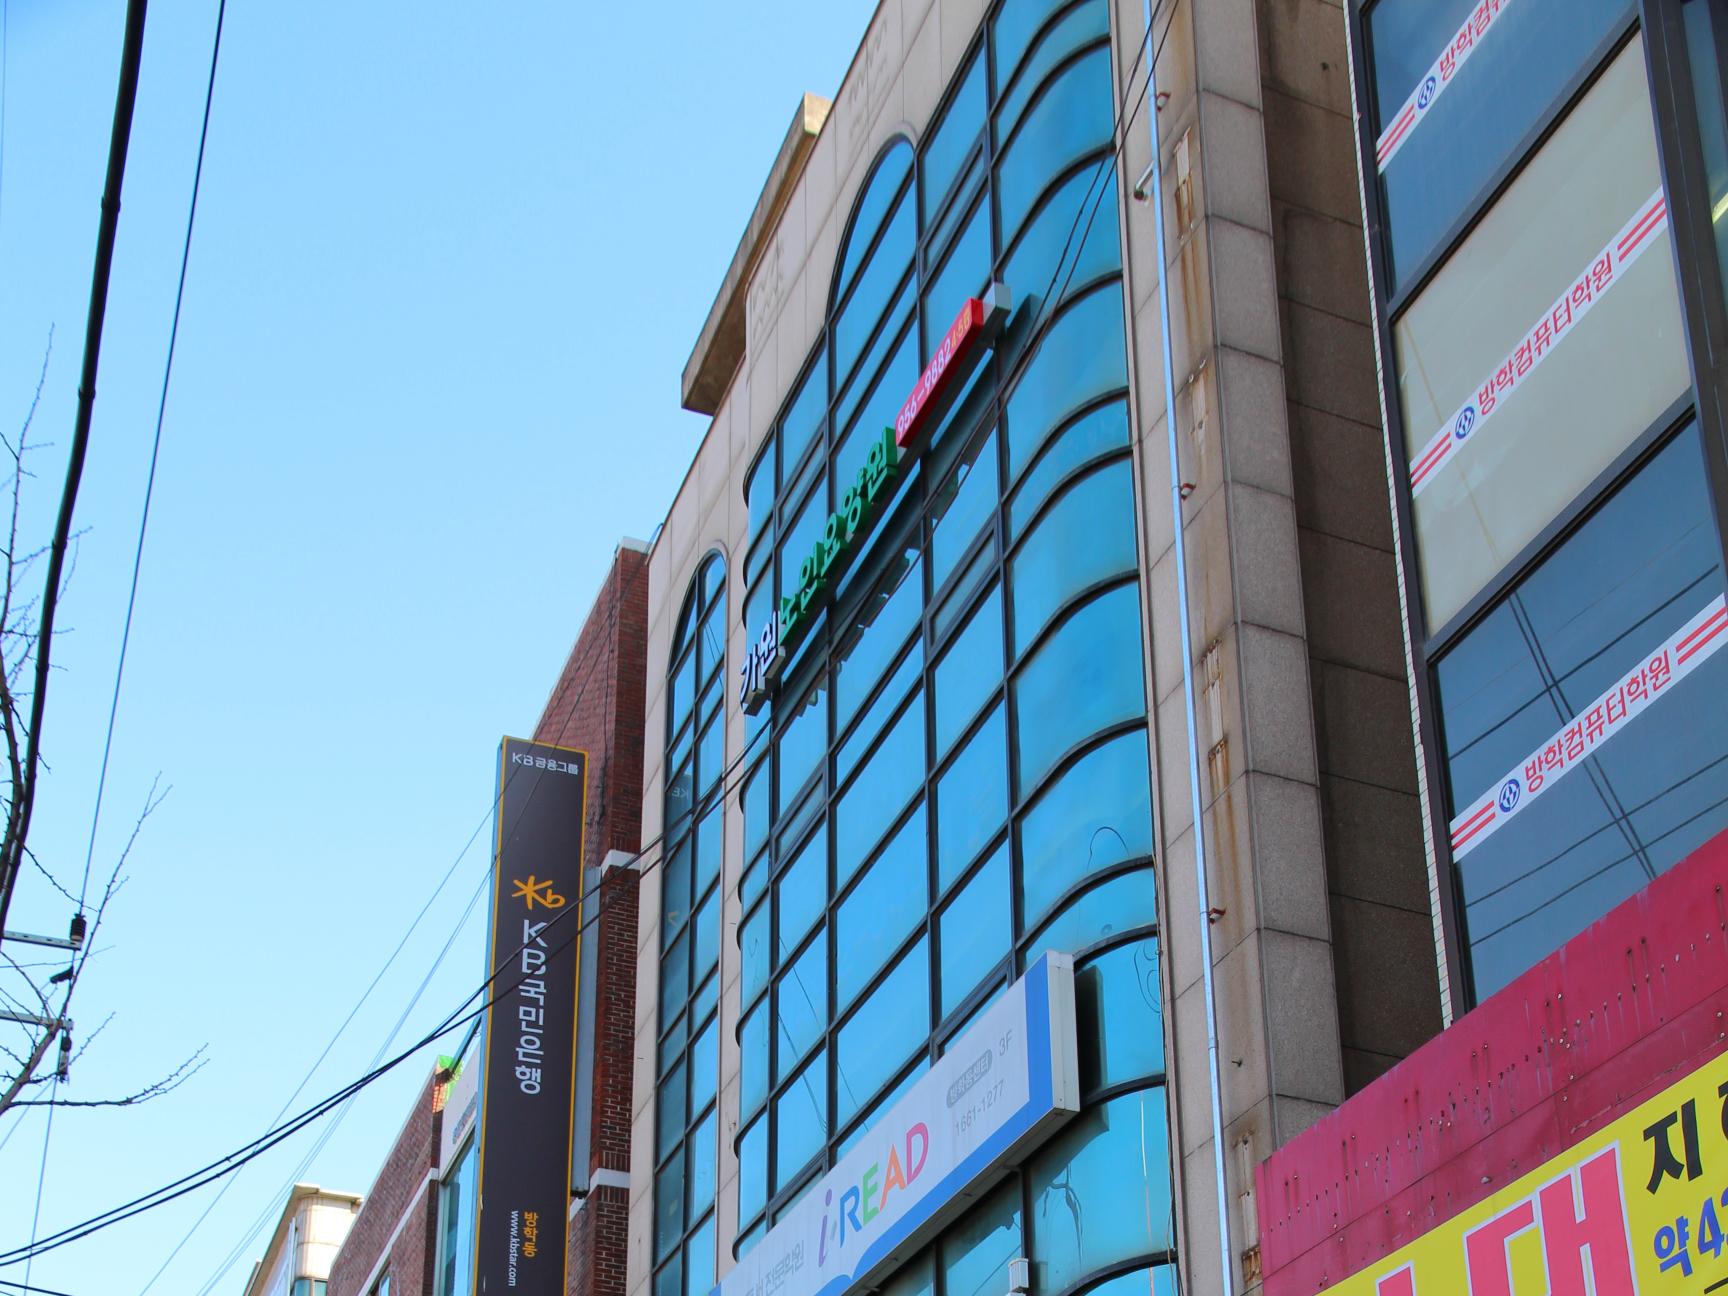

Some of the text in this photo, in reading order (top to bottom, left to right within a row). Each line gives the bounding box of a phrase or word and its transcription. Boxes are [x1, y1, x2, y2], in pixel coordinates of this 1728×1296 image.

[1478, 253, 1614, 415] 방학컴퓨터학원
[1525, 649, 1672, 794] 방학컴퓨터학원
[516, 919, 548, 1095] KB국민은행
[508, 1210, 519, 1287] www.kbstar.com
